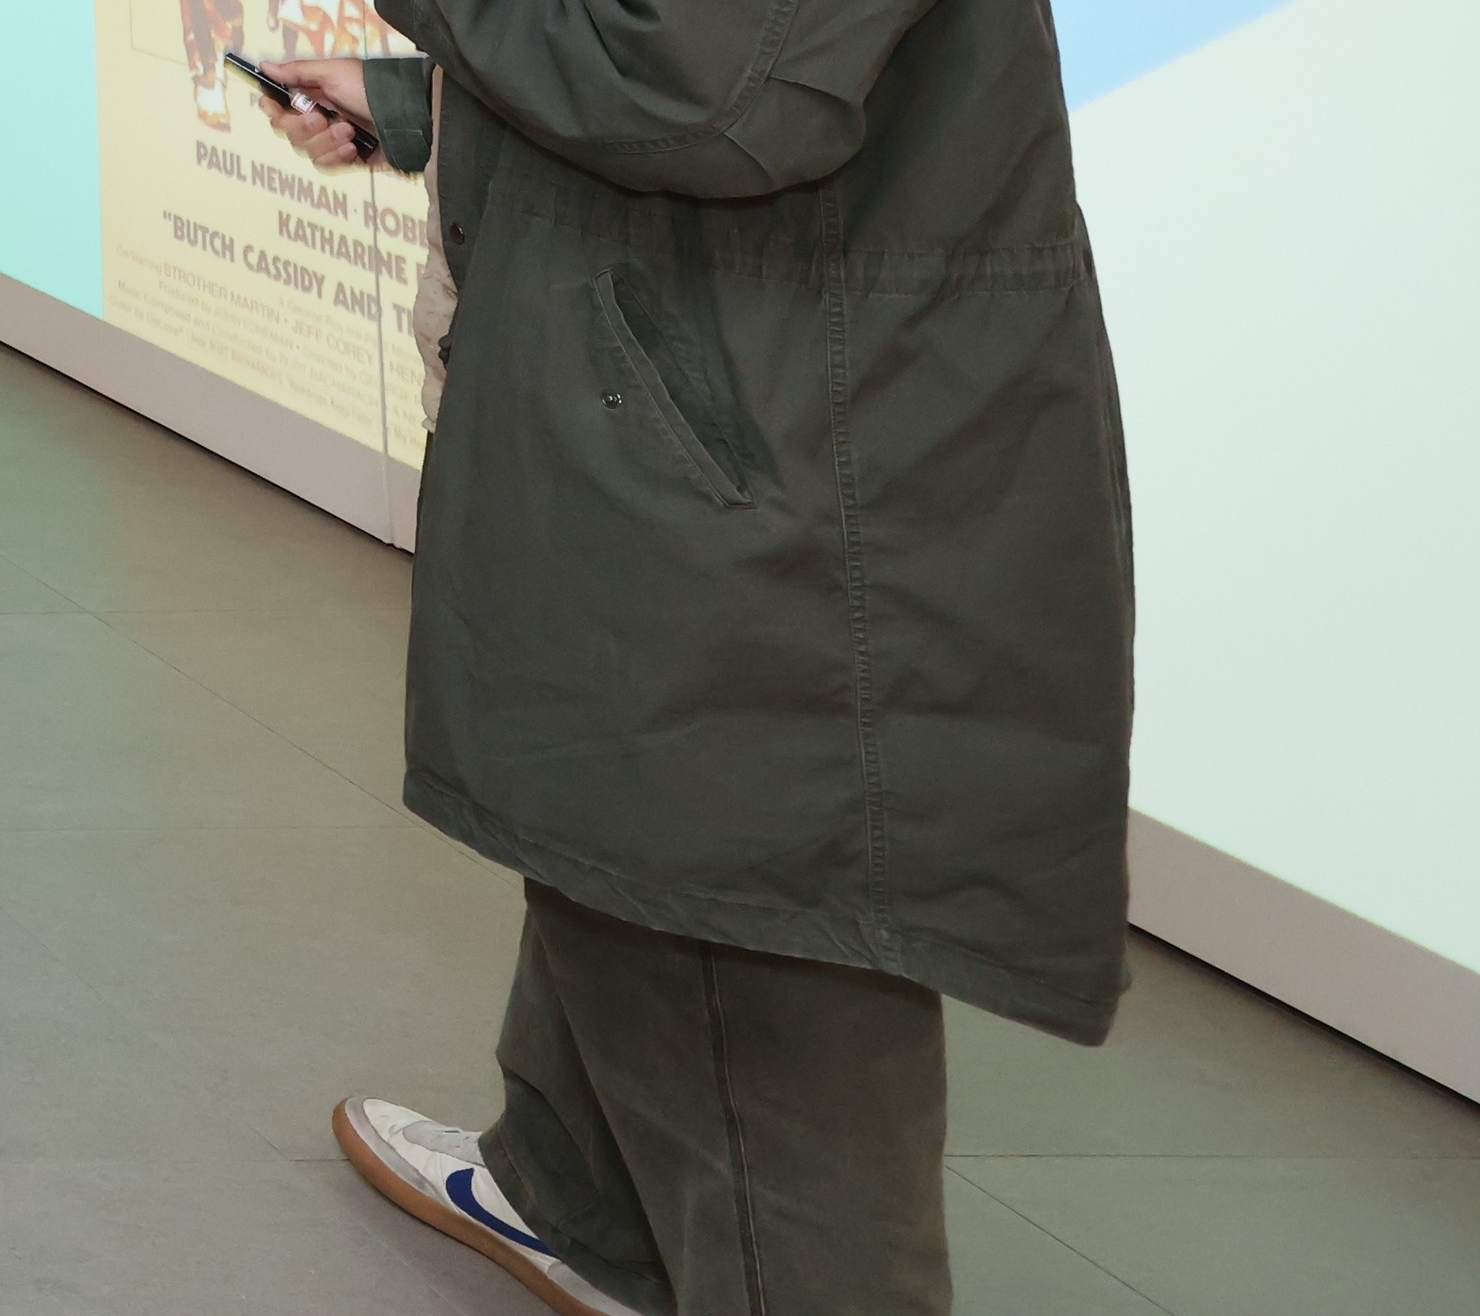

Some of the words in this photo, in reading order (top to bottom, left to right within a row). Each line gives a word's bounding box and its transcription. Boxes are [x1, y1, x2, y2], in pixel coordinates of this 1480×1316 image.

[195, 139, 247, 183] PAUL
[250, 159, 349, 221] NEWMAN
[242, 244, 326, 300] CASSIDY
[333, 280, 381, 323] AND
[277, 210, 409, 286] KATHARINE
[163, 261, 228, 302] STROTHER
[230, 290, 281, 325] MARTIN
[292, 319, 321, 343] JEFF
[326, 333, 373, 366] COREY
